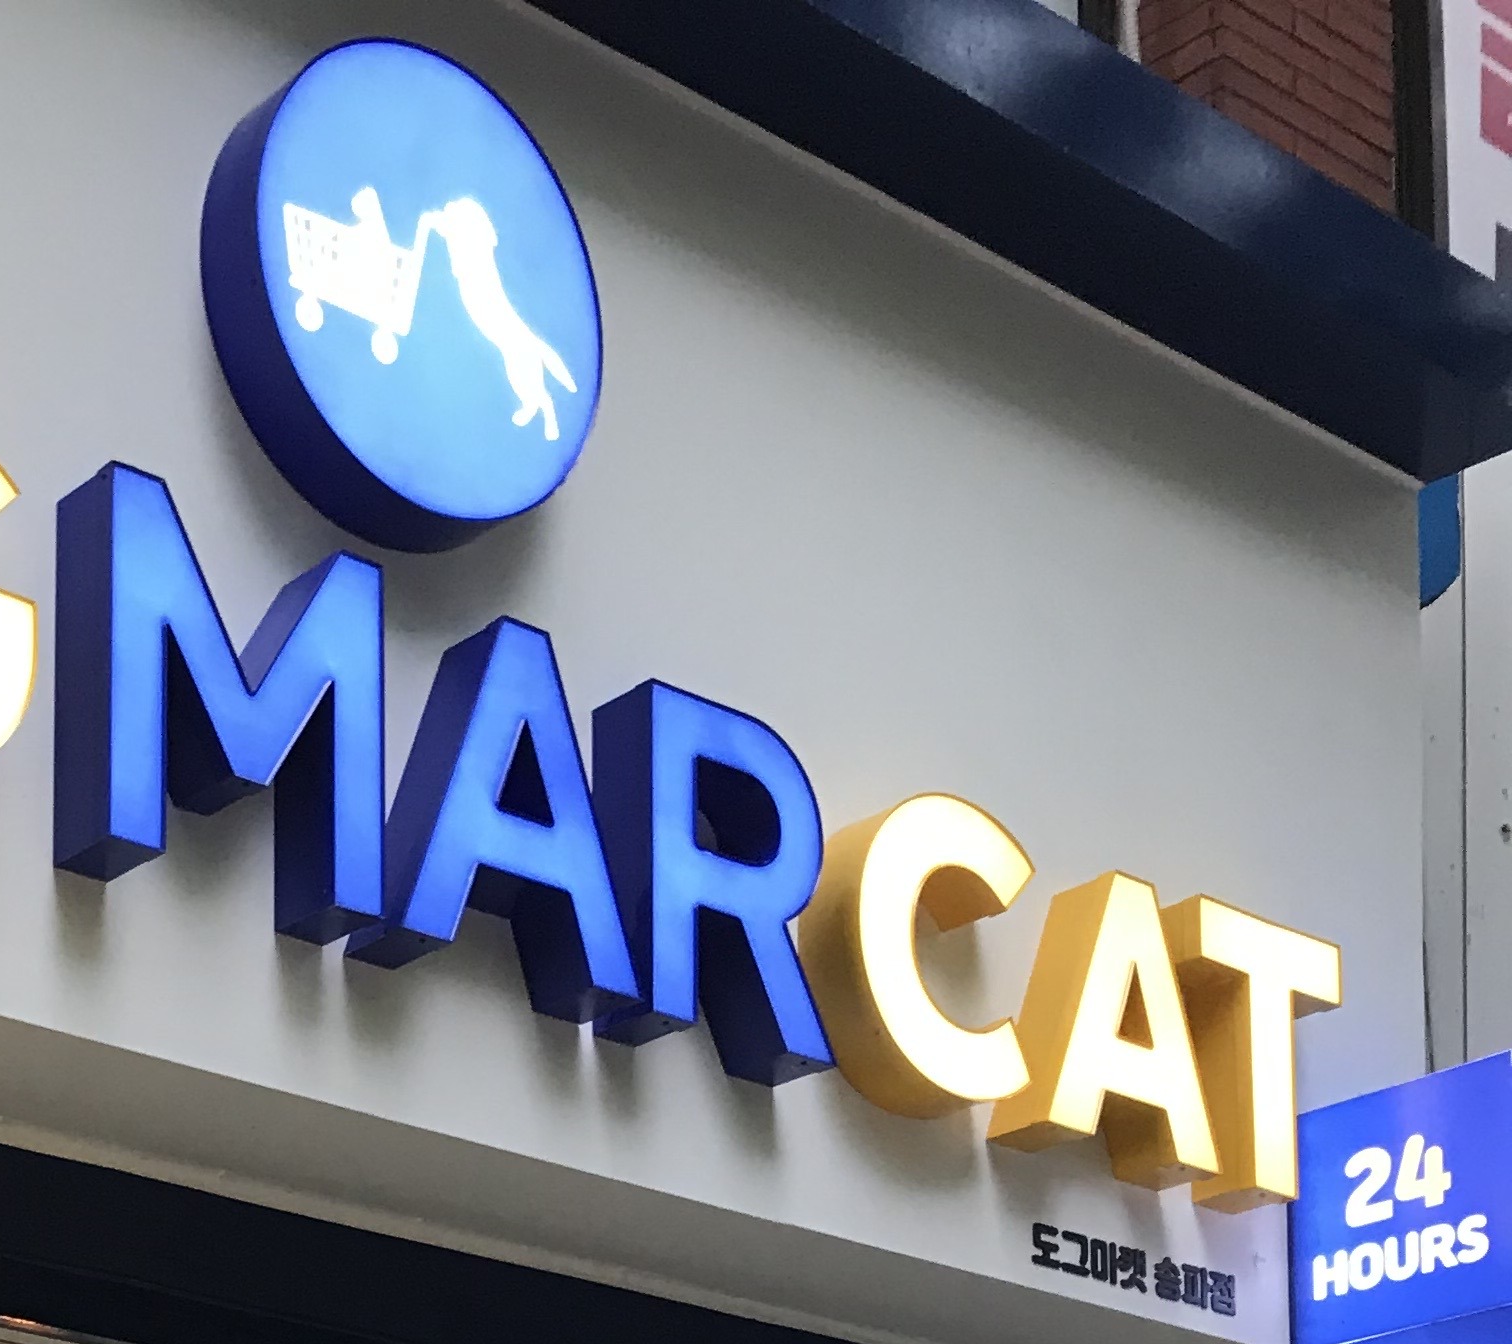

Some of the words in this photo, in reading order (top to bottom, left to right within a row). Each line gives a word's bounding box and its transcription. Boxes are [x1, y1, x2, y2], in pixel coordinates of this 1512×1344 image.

[1343, 1134, 1452, 1228] 24
[1153, 1256, 1237, 1317] 송파점
[1311, 1213, 1489, 1301] HOURS
